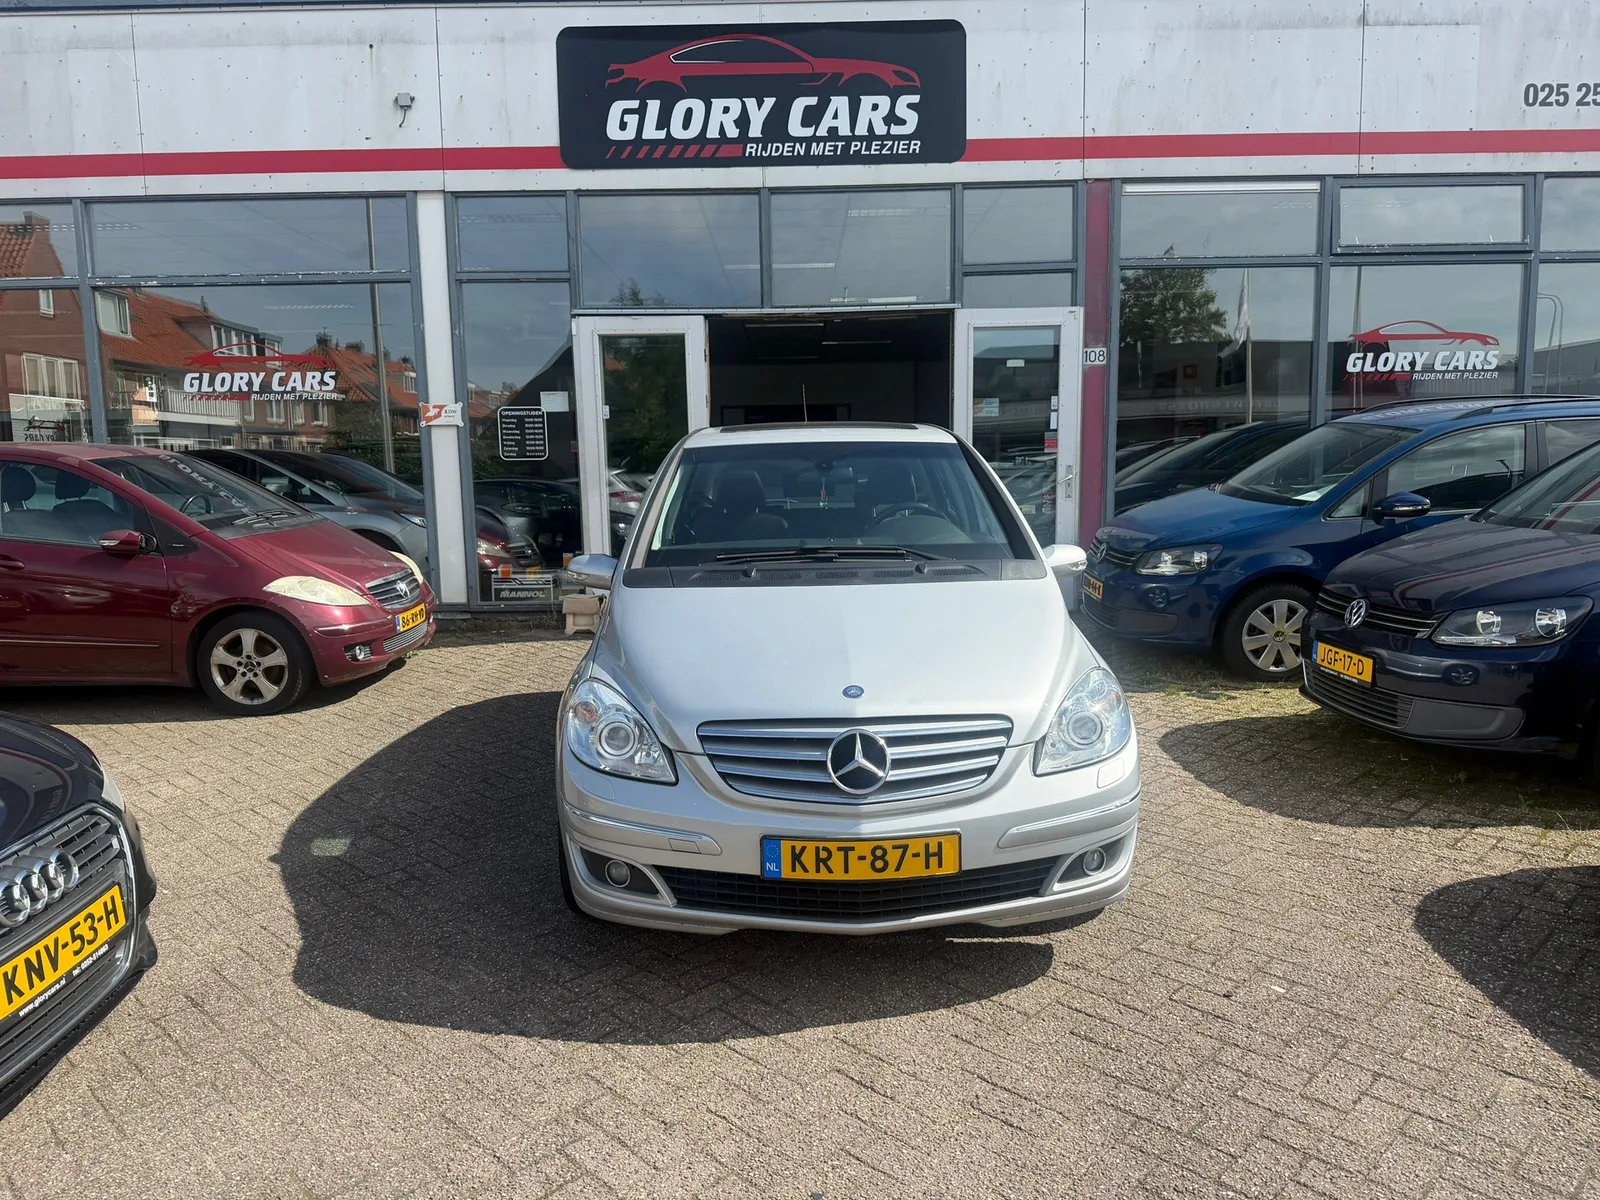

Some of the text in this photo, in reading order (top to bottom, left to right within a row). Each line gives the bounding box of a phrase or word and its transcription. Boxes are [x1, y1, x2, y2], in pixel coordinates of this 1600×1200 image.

[1523, 83, 1570, 107] 025
[605, 94, 921, 140] GLORY CARS
[745, 140, 921, 157] RIJDEN MET PLEZIER
[1084, 349, 1106, 363] 108
[1346, 350, 1500, 373] GLORY CARS
[183, 371, 337, 393] GLORY CARS
[1443, 372, 1461, 380] MET
[1463, 371, 1499, 379] PLEZIER
[251, 393, 282, 401] RIJDEN
[302, 392, 338, 400] PLEZIER
[500, 590, 546, 598] MANNOL
[1320, 647, 1364, 676] JGF-17-D
[766, 840, 943, 874] NL KRT-87-H
[2, 894, 120, 1006] KNV-53-H
